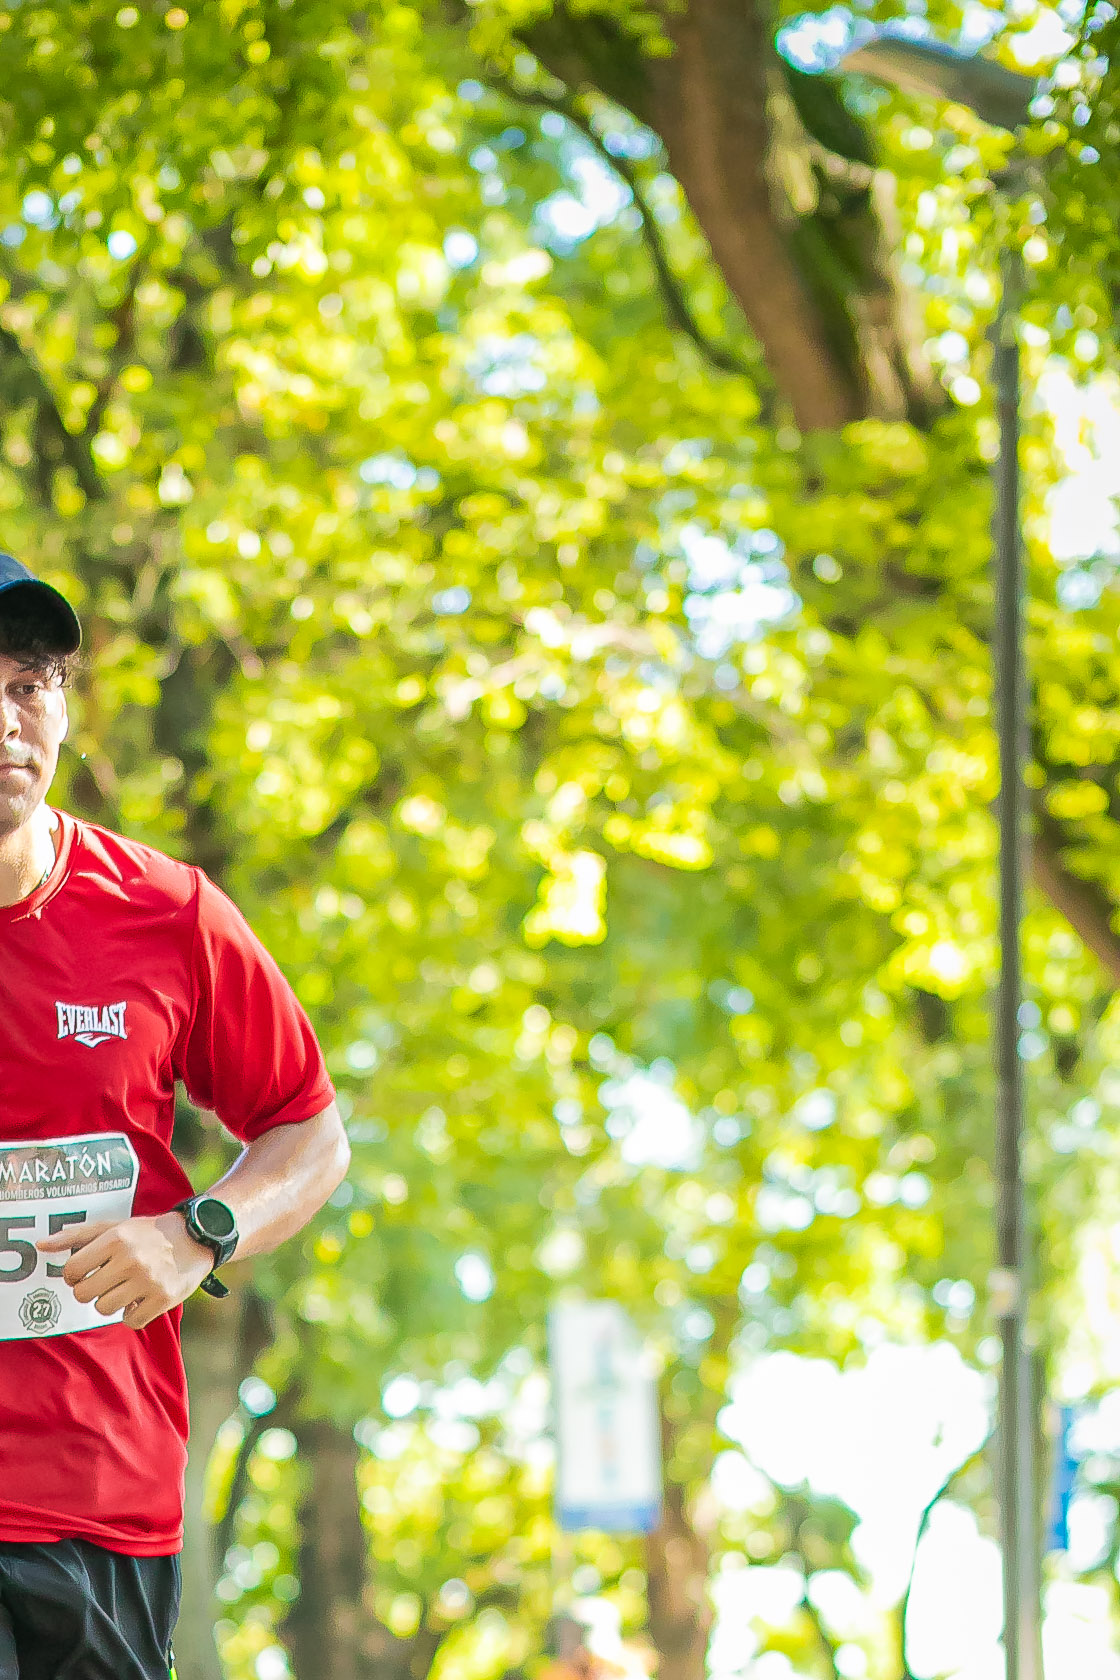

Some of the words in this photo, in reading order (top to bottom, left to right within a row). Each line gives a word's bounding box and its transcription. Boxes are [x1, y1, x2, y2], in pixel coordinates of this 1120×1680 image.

[55, 1001, 127, 1039] EVERLAST
[0, 1188, 44, 1201] BOMBEROS
[46, 1182, 97, 1198] VOLUNTARIOS
[99, 1178, 130, 1192] ROSARIO
[33, 1302, 50, 1318] 27
